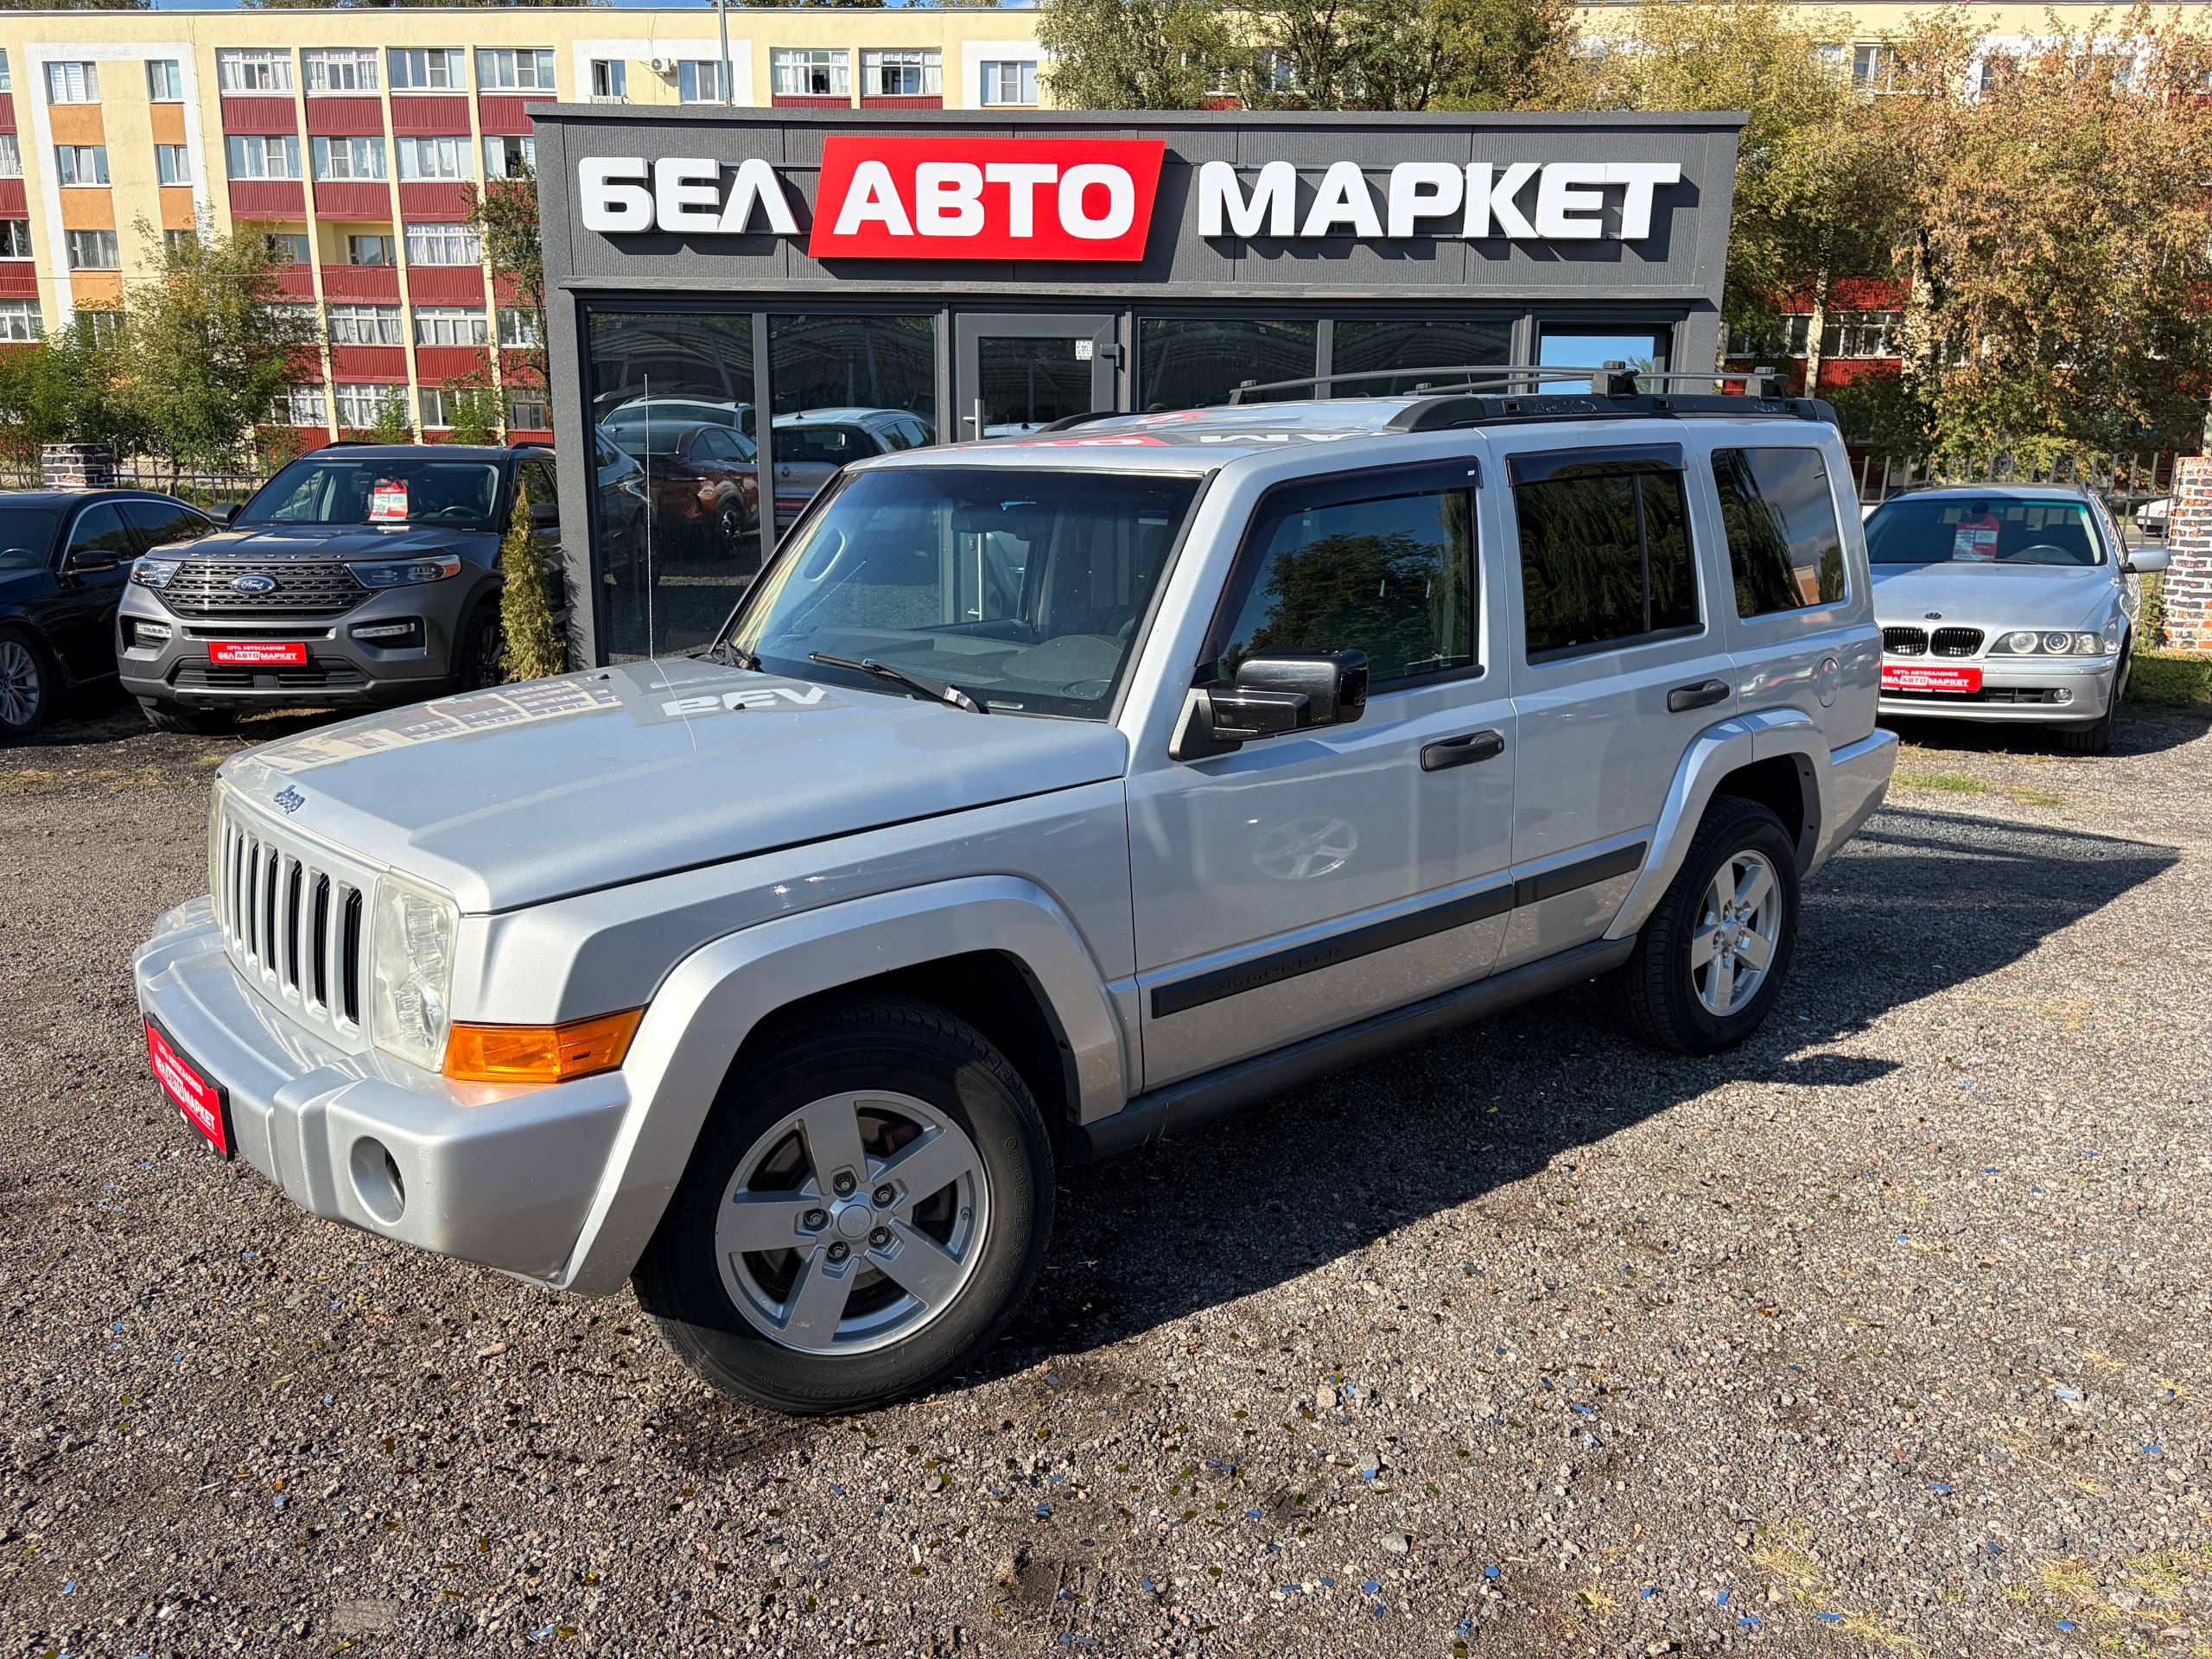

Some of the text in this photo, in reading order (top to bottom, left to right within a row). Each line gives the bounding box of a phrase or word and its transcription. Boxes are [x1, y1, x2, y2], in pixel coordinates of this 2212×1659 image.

[578, 156, 1681, 240] БЕЛ АВТО МАРКЕТ
[240, 579, 264, 590] Ford
[273, 784, 306, 816] Jeep
